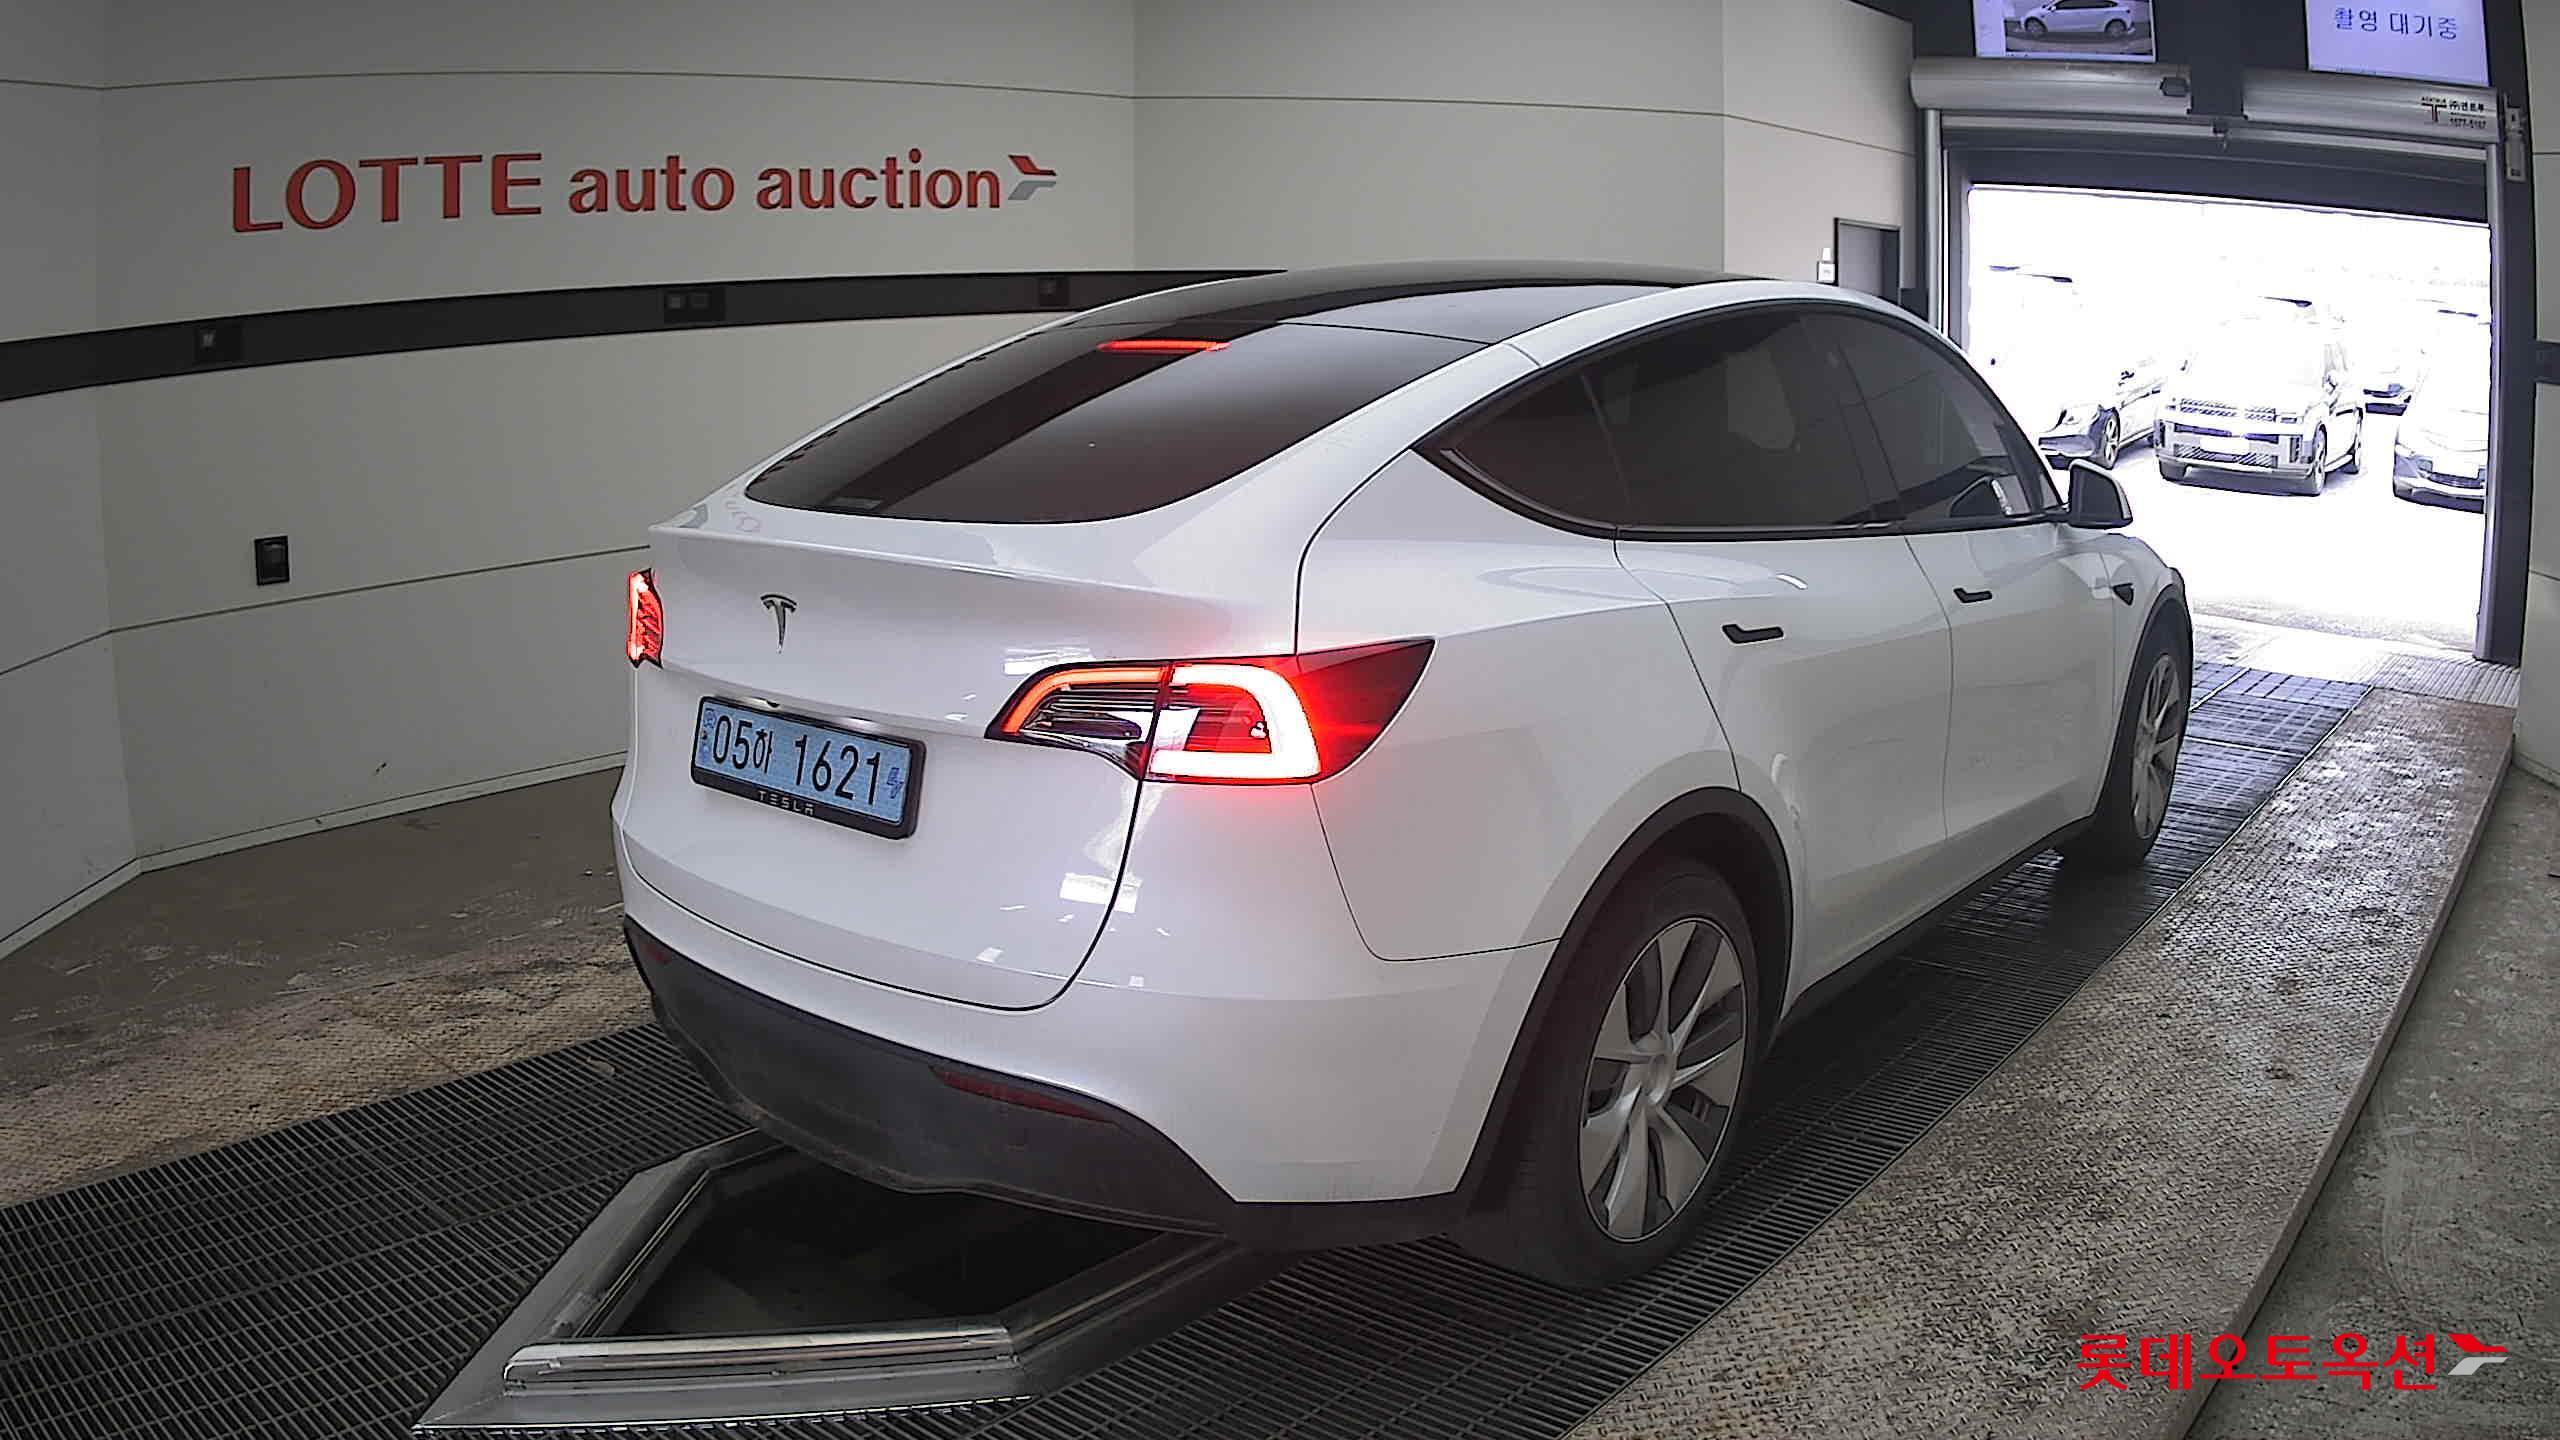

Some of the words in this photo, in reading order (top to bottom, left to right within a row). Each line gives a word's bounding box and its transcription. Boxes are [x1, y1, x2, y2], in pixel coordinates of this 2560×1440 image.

[2335, 7, 2378, 32] 촬영
[2389, 12, 2457, 40] 대기중
[233, 152, 543, 233] LOTTE
[569, 154, 735, 213] auto
[757, 148, 1002, 209] auction
[712, 714, 774, 775] 05하
[795, 733, 881, 806] 1621
[758, 790, 815, 816] TESLA
